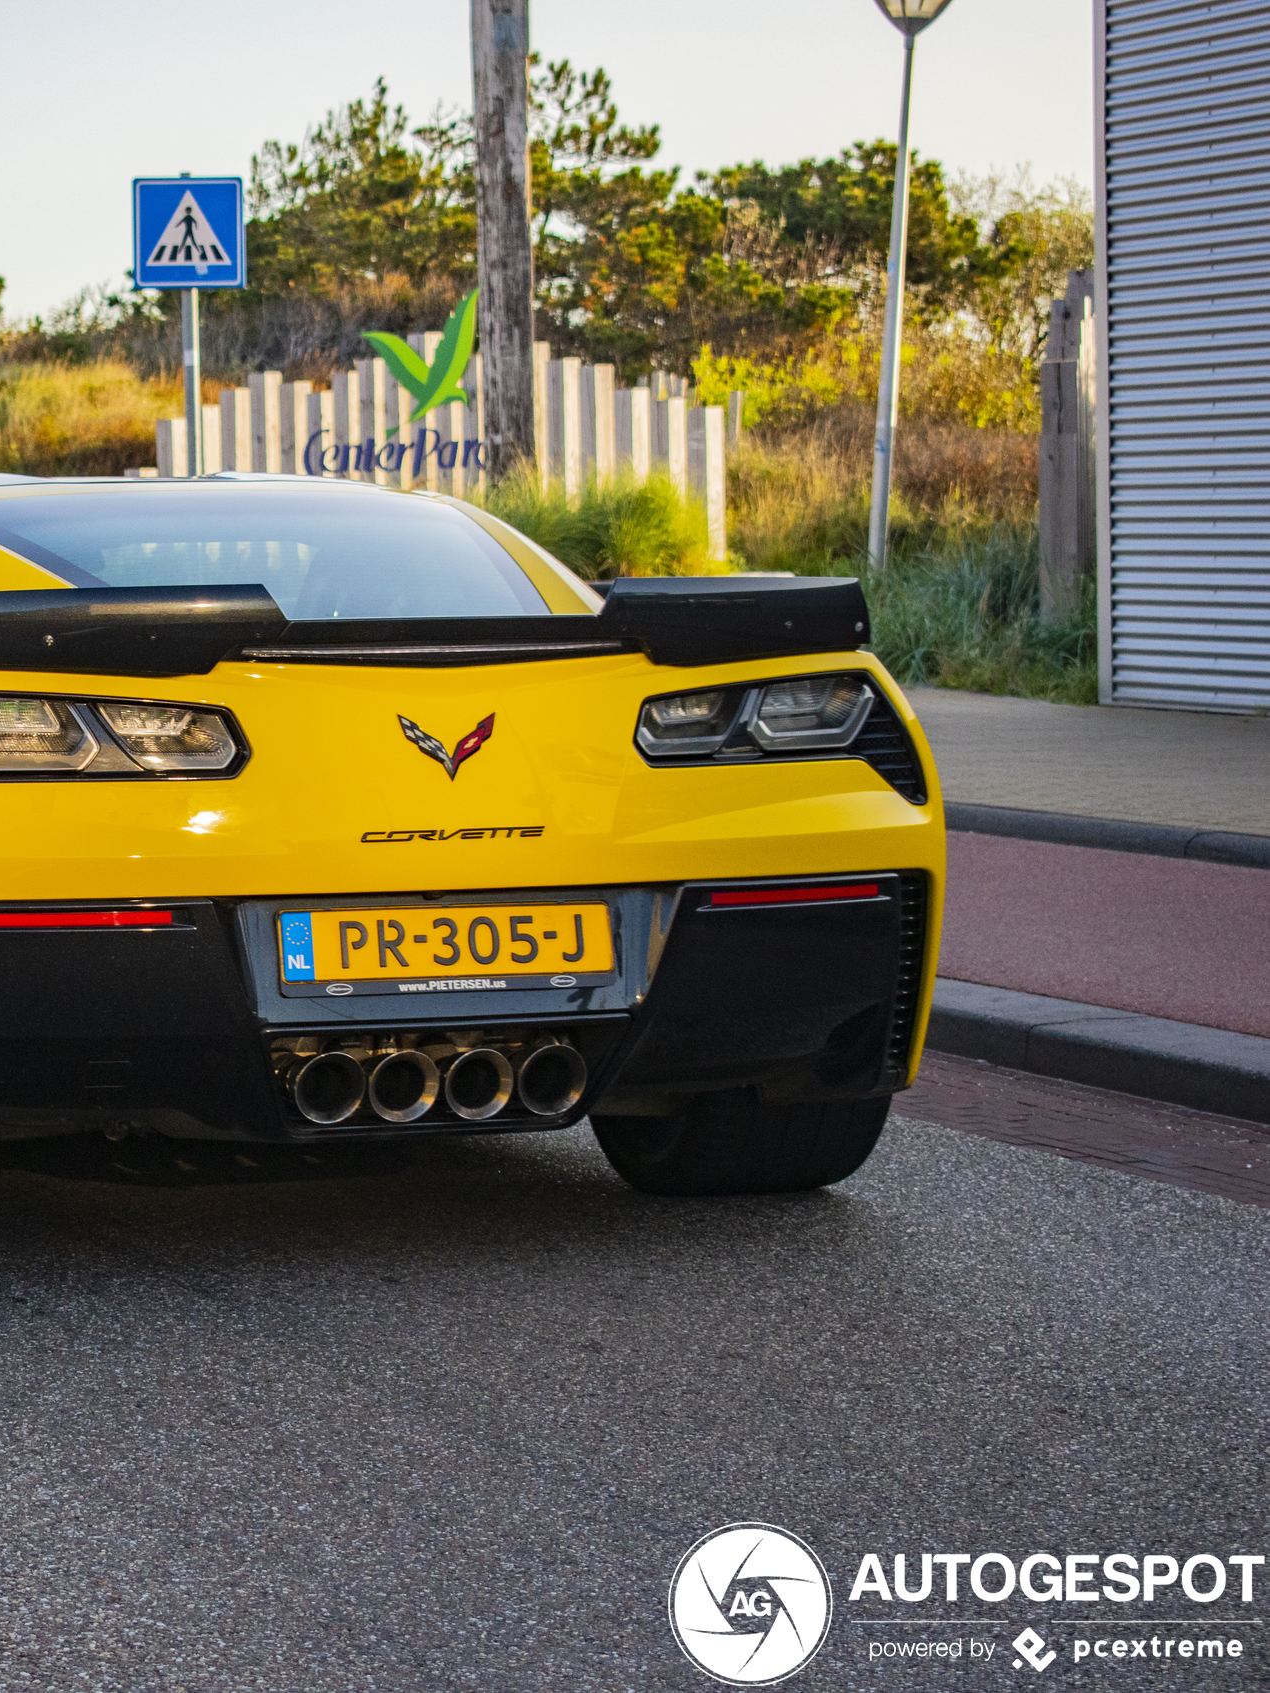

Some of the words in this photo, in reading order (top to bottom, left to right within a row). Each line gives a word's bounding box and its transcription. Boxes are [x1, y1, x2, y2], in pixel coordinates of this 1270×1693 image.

[361, 825, 545, 843] CORVETTE
[339, 914, 585, 969] PR-305-J
[287, 953, 311, 970] NL
[397, 978, 507, 992] www.PIETERSEN.us
